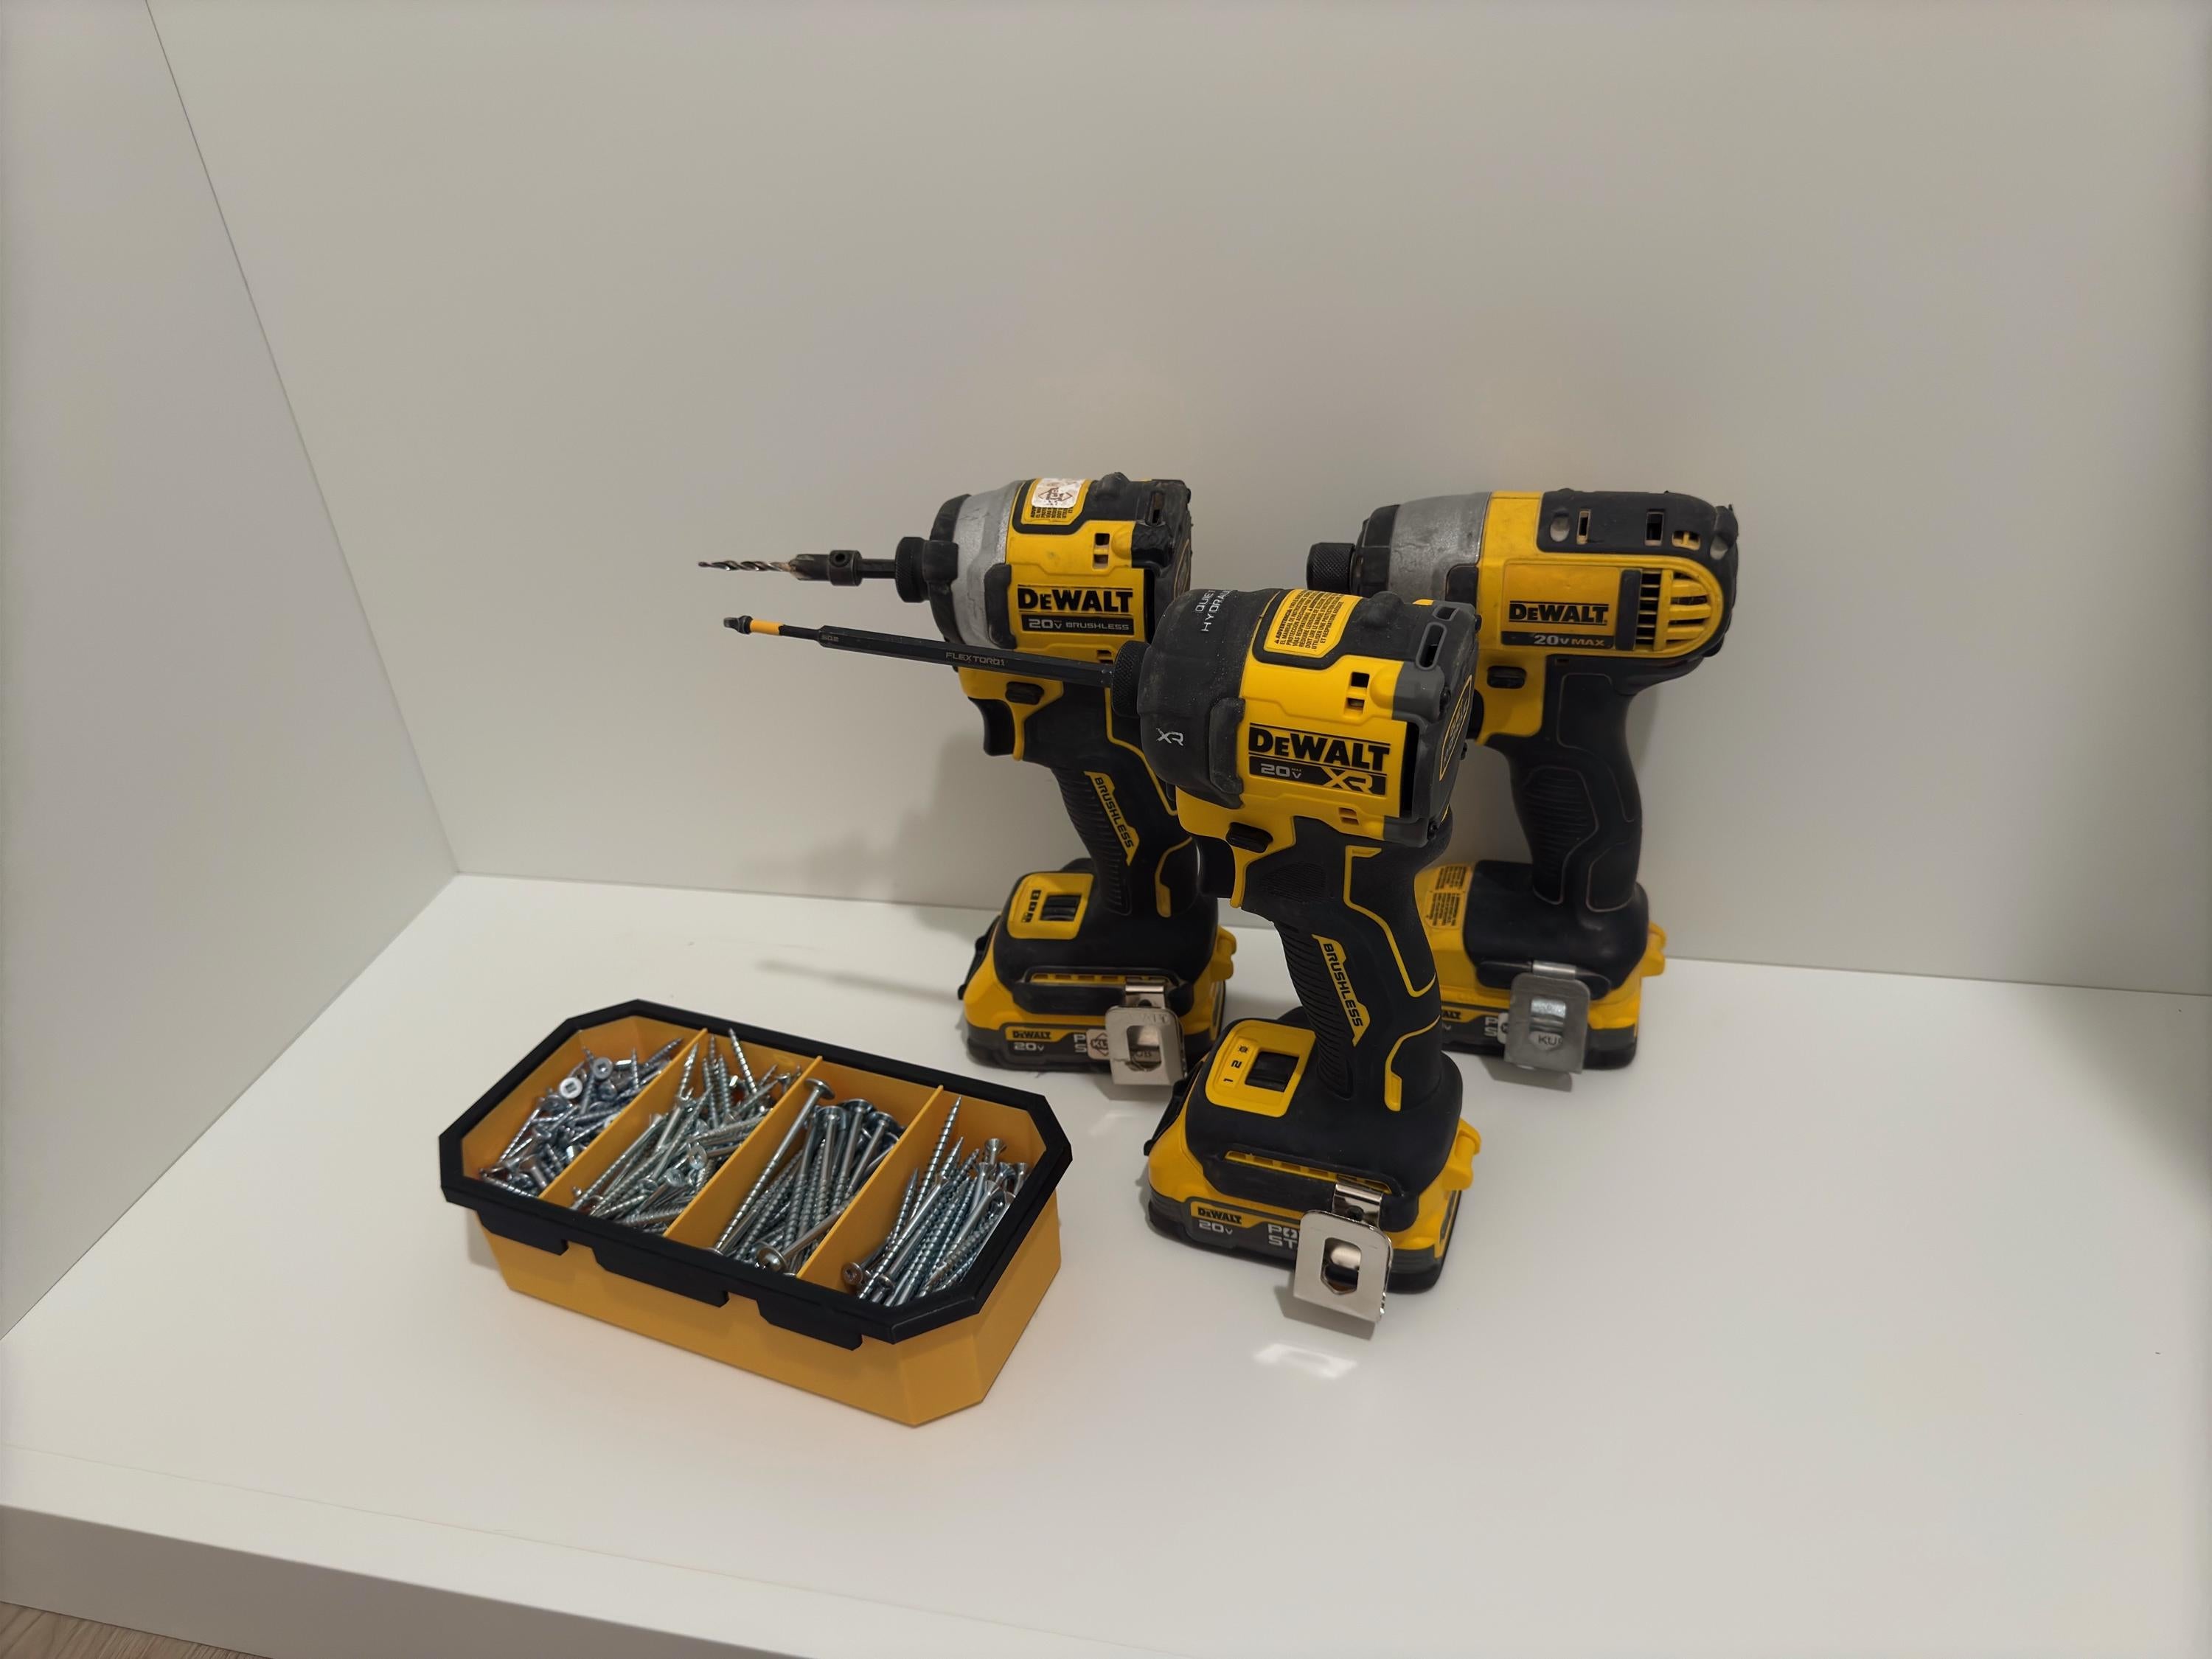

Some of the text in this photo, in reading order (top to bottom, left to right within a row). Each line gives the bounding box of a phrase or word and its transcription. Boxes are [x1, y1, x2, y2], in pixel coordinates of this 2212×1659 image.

[1200, 590, 1233, 632] HYDRAU
[1065, 622, 1129, 630] BRUSHLESS
[1312, 630, 1322, 649] UTILISER
[1571, 638, 1604, 646] MAX
[1156, 728, 1183, 746] XR
[1095, 776, 1133, 848] BRUSHLESS
[1324, 943, 1363, 1027] BRUSHLESS
